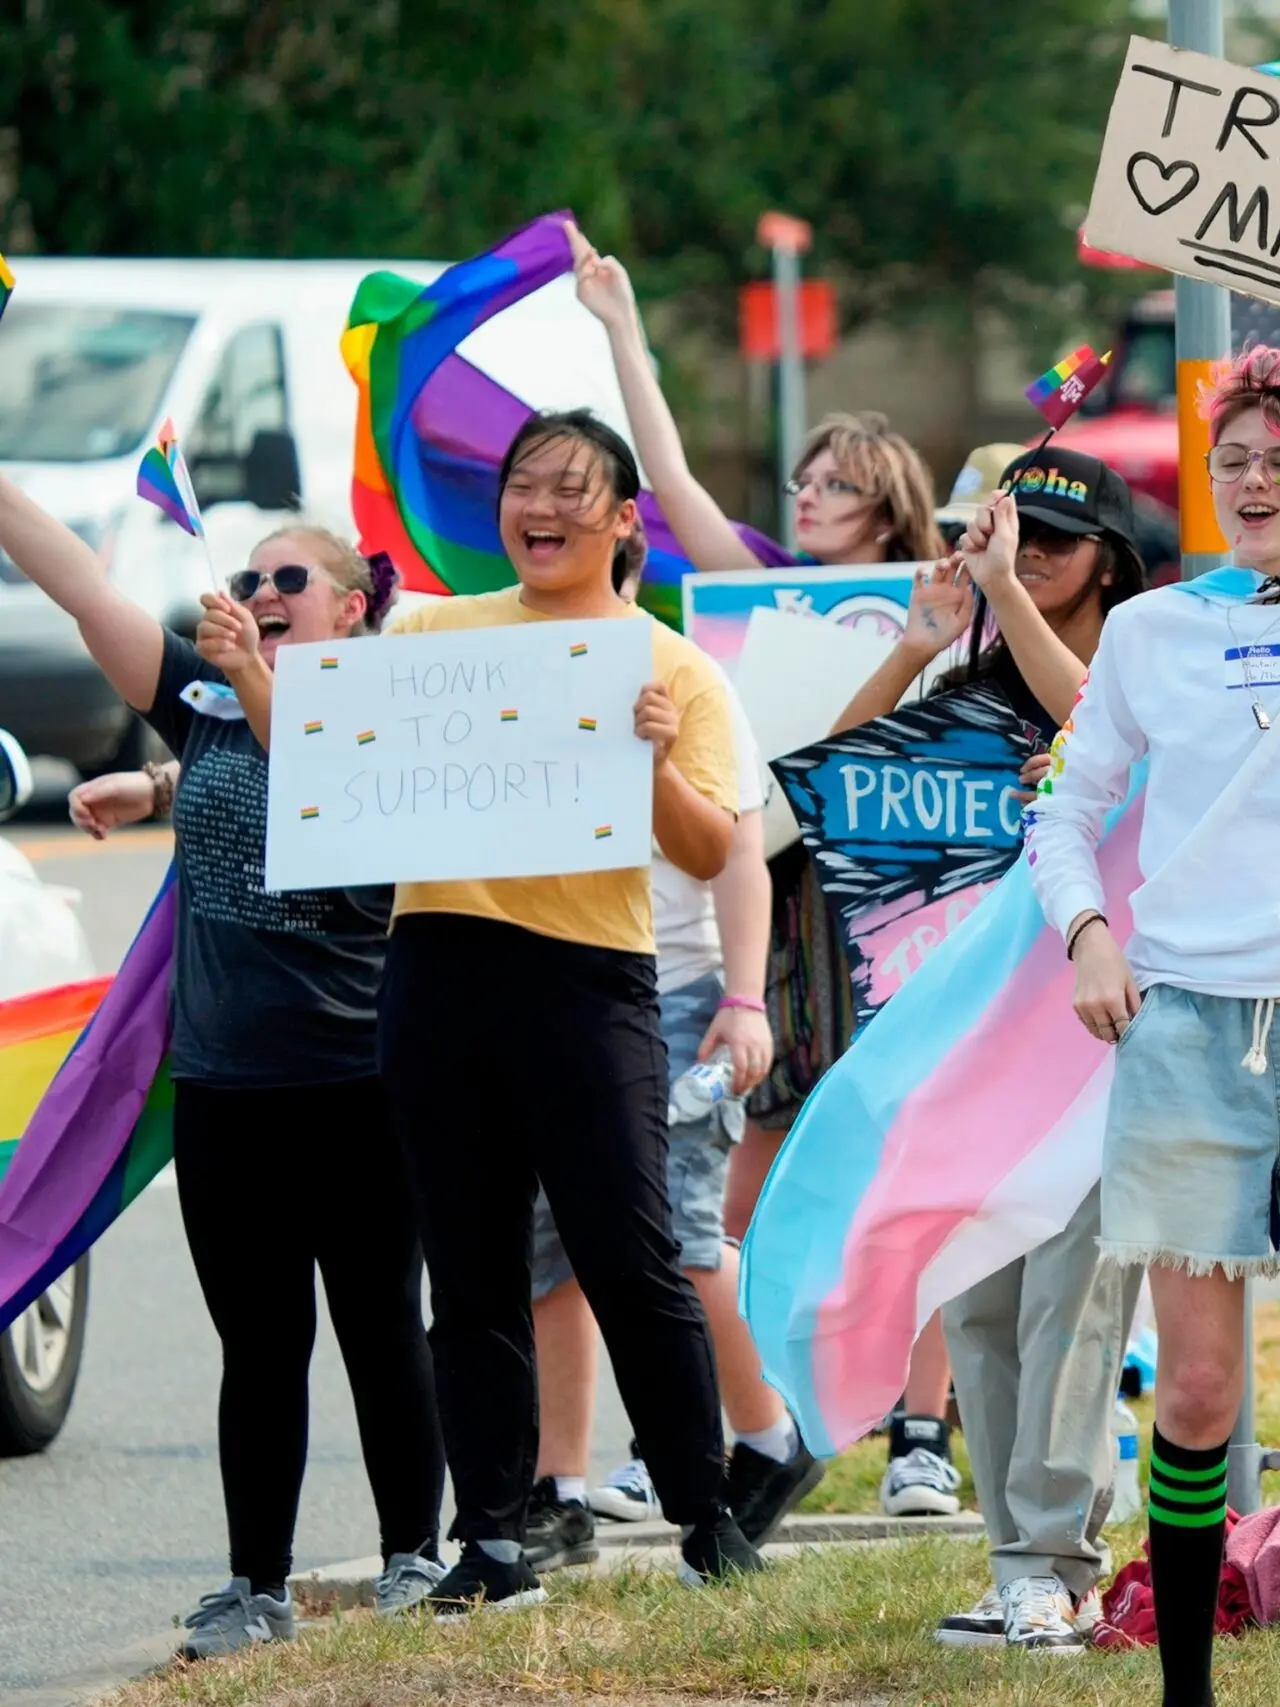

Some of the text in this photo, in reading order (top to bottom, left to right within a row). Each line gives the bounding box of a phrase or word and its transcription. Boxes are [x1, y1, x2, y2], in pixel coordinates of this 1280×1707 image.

[389, 660, 507, 700] HONK
[402, 710, 472, 747] TO
[342, 760, 581, 824] SUPPORT!
[840, 764, 1022, 839] PROTEC
